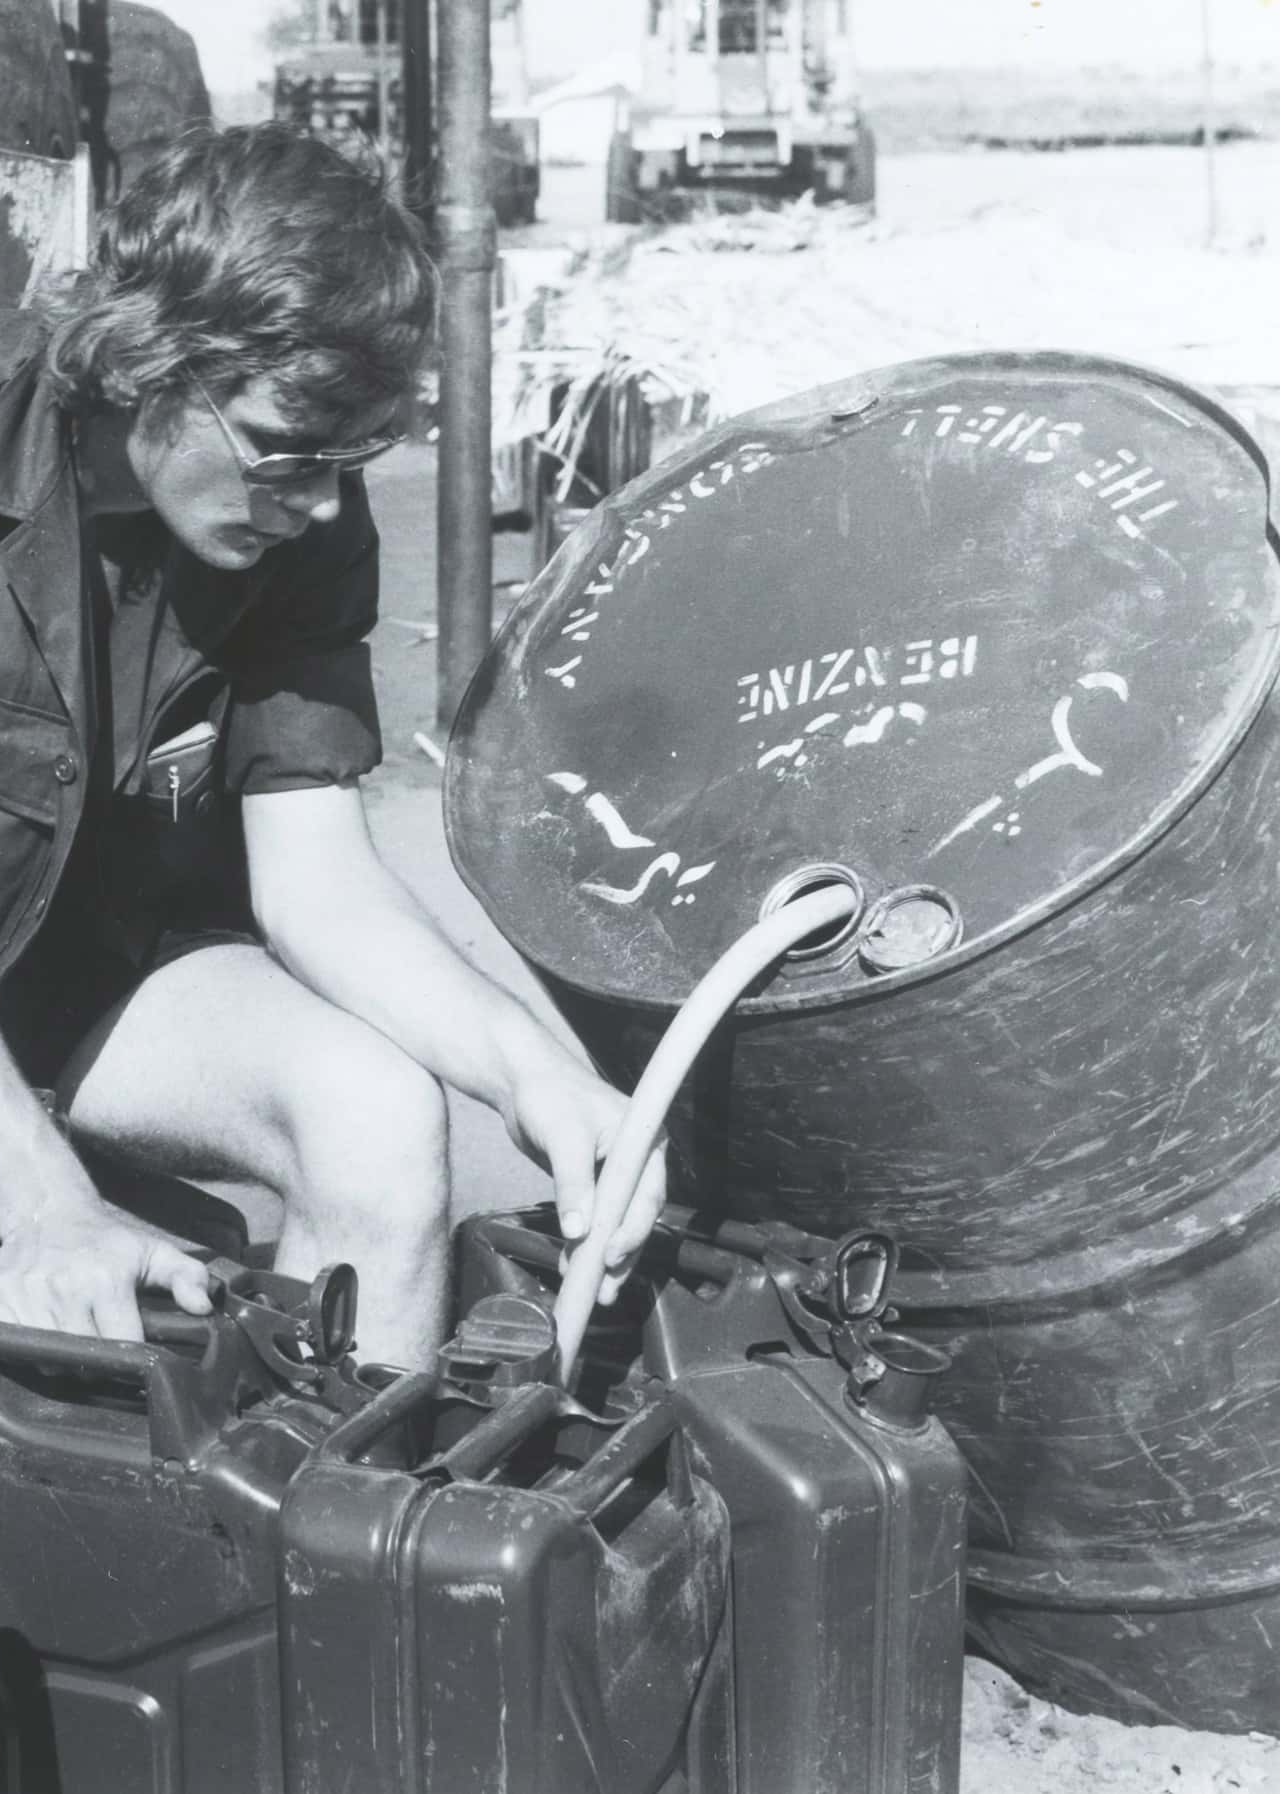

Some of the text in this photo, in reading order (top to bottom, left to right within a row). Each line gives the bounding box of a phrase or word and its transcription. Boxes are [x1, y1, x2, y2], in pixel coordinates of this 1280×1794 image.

[900, 403, 1085, 464] SHELL
[1074, 447, 1180, 540] THE
[735, 634, 979, 724] BENZINE
